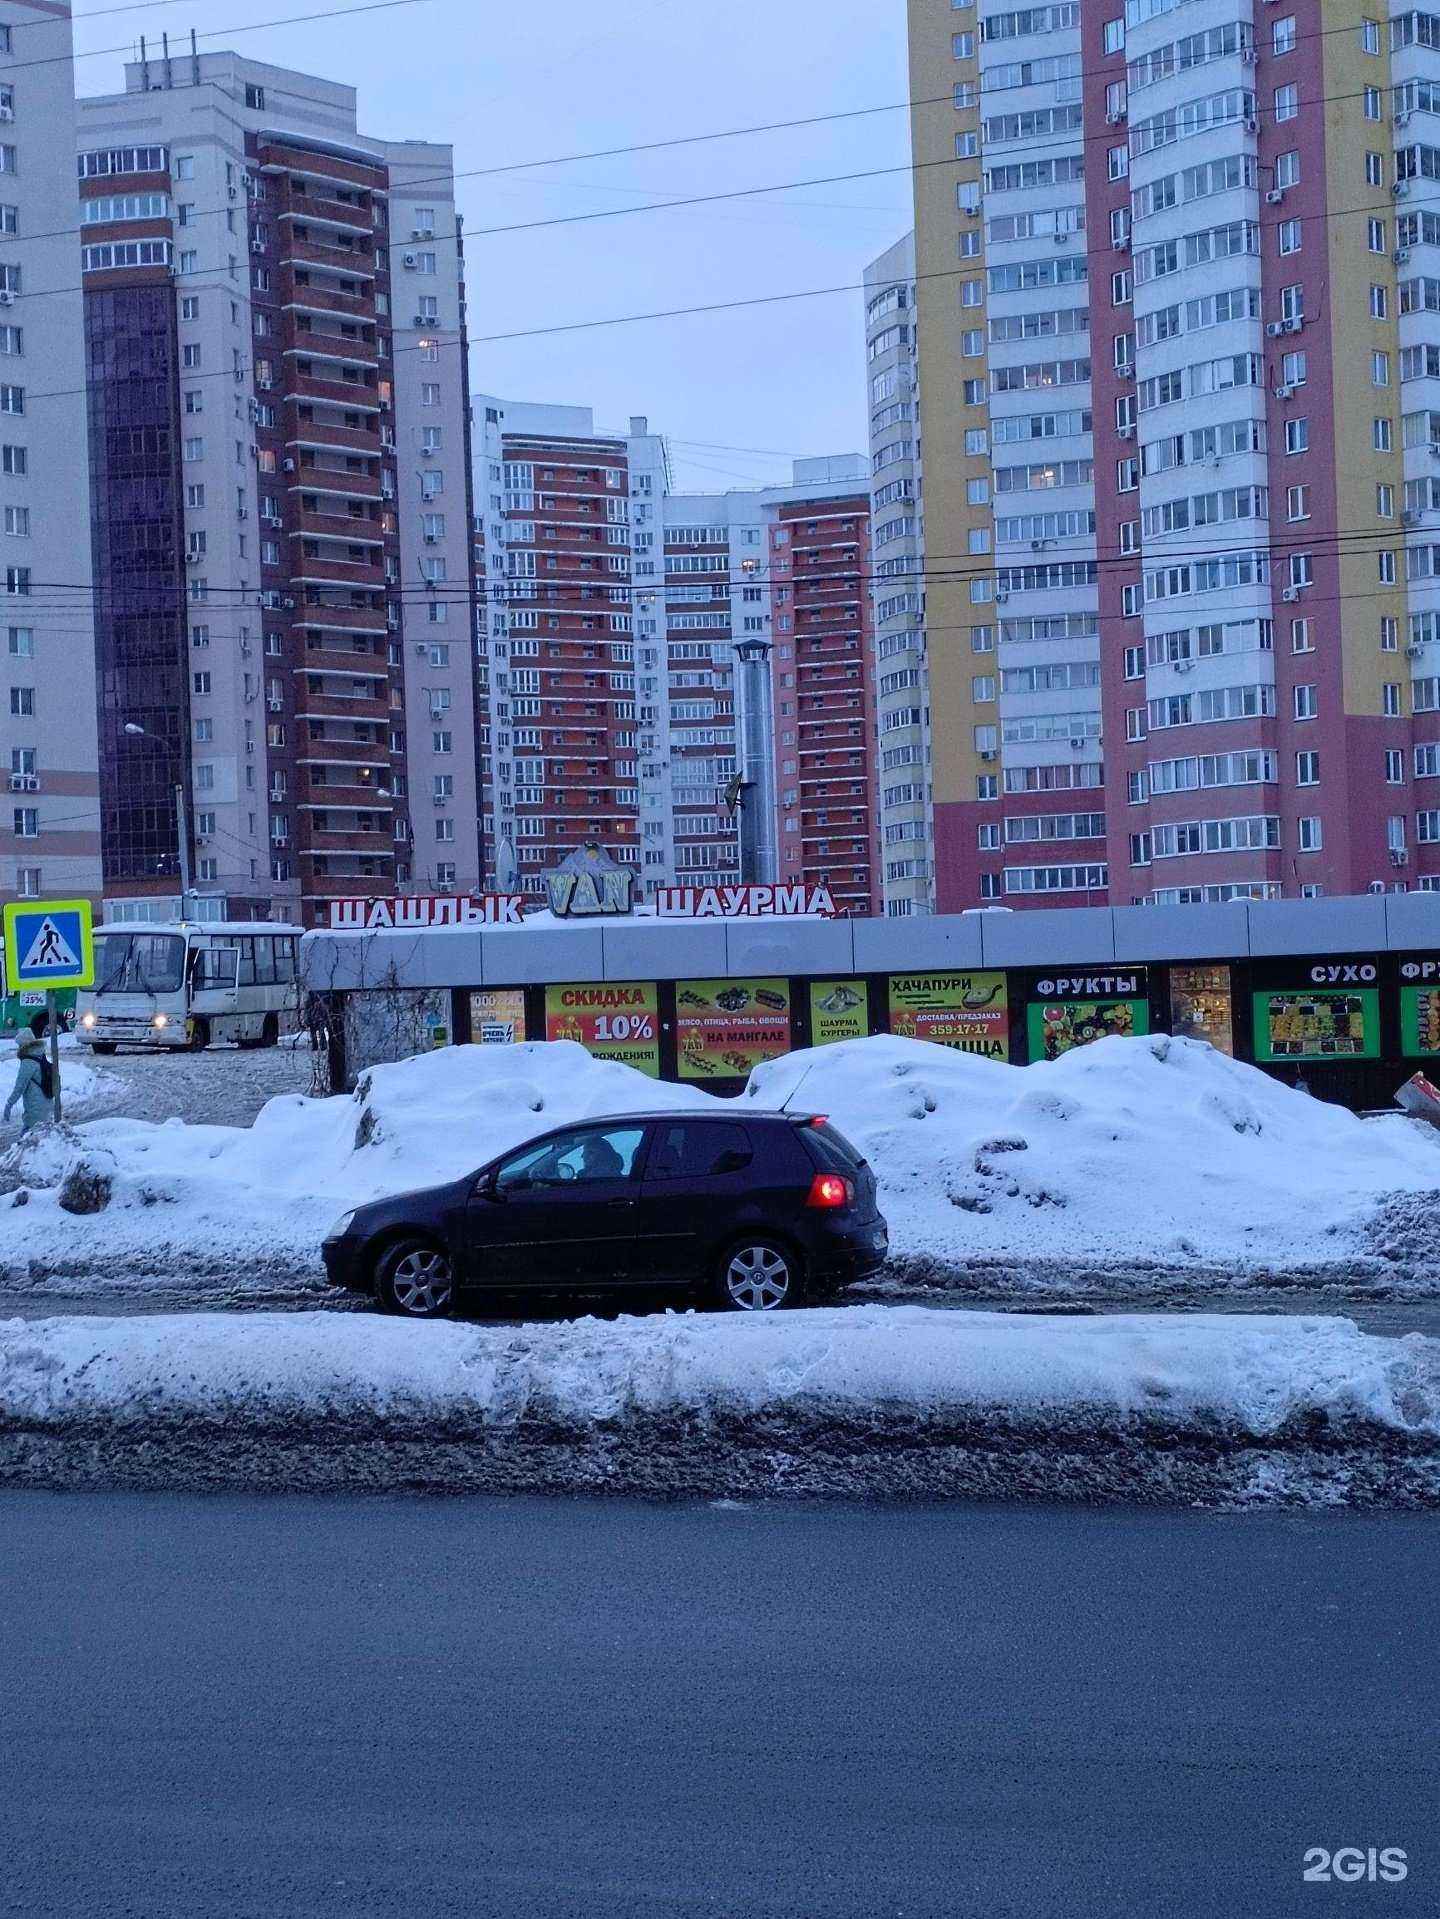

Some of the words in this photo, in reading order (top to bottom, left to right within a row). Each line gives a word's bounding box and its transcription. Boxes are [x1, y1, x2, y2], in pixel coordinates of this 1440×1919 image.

[548, 869, 632, 915] VAN
[657, 885, 836, 917] ШАУРМА
[330, 895, 523, 929] ШАШЛЫК
[1311, 964, 1377, 983] СУХО
[1401, 962, 1440, 978] ФР
[892, 979, 972, 992] ХАЧАПУРИ
[1037, 976, 1137, 995] ФРУКТЫ
[561, 989, 645, 1008] СКИДКА
[594, 1015, 653, 1039] 10%
[759, 1017, 788, 1025] ОВОЩИ
[820, 1019, 858, 1028] ШАУРМА
[707, 1033, 723, 1042] НА
[727, 1031, 785, 1042] МАНГАЛЕ
[820, 1028, 860, 1037] БУРГЕРЫ
